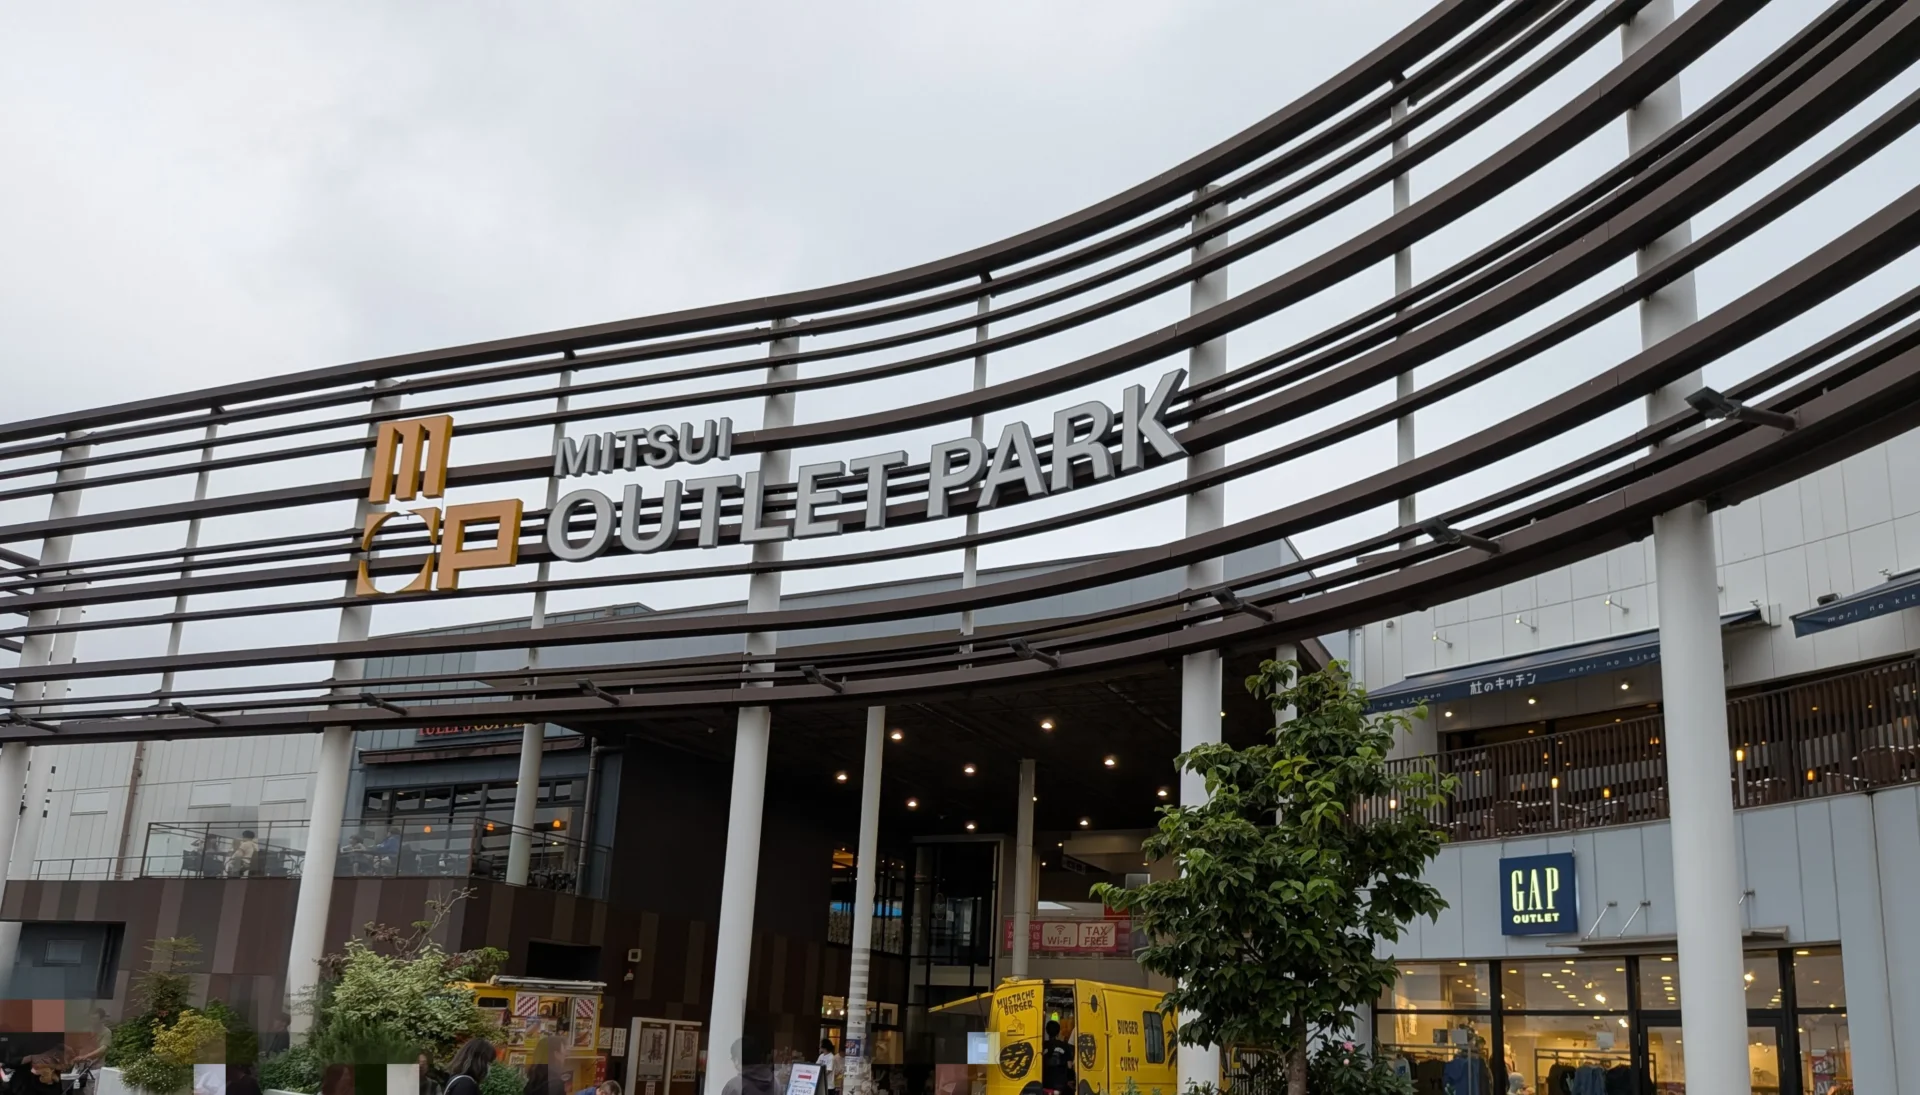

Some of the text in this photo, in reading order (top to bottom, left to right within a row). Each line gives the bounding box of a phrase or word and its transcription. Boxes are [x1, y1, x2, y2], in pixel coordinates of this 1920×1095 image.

[554, 417, 733, 479] MITSUI
[546, 367, 1189, 562] OUTLET PARK
[1869, 603, 1884, 613] no
[1469, 673, 1537, 696] 杜のキッチン
[1511, 867, 1560, 912] GAP
[1512, 912, 1560, 924] OUTLET
[1086, 926, 1108, 936] TAX
[1084, 936, 1109, 946] FREE
[996, 989, 1035, 1009] MUSTACHE
[1003, 1000, 1034, 1016] BURGER
[1117, 1019, 1139, 1035] BURGER
[1120, 1056, 1140, 1072] CURRY
